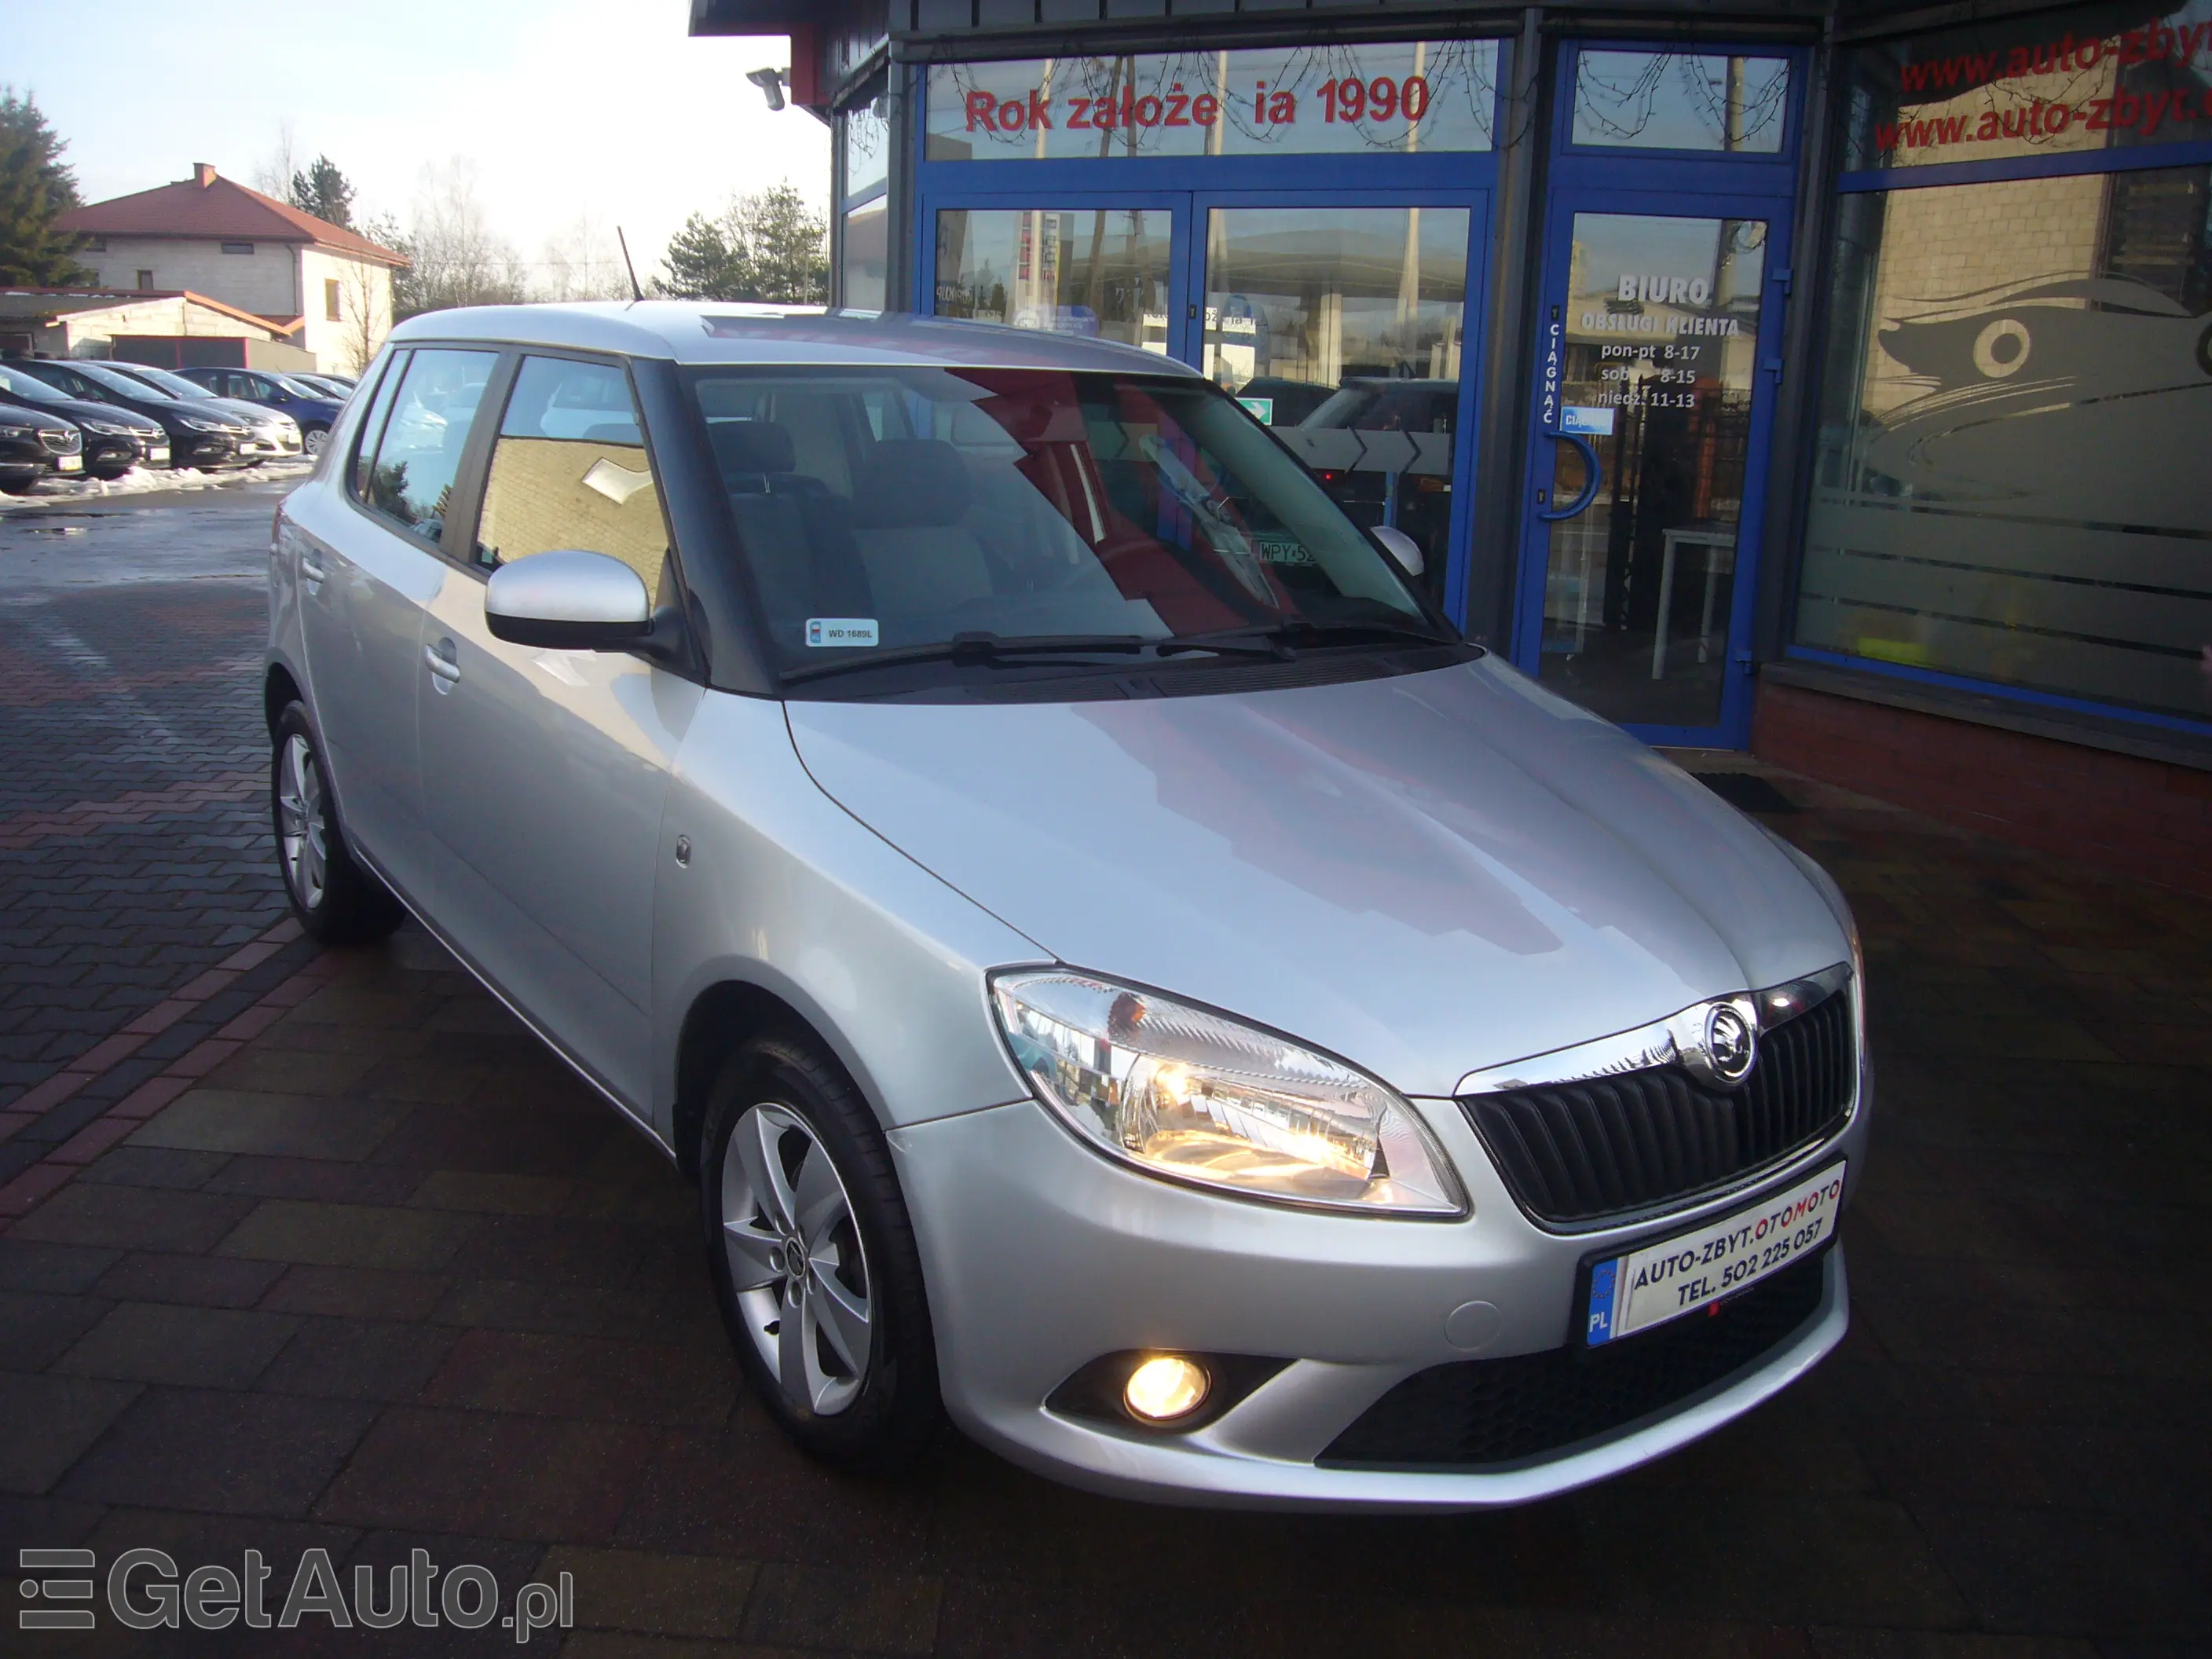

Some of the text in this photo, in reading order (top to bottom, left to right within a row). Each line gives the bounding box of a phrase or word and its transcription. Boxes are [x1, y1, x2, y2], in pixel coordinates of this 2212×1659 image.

[966, 89, 1052, 133] Rok
[1317, 75, 1429, 123] 1990
[1618, 275, 1711, 304] BIURO
[1581, 313, 1738, 337] OBSŁUGI KLIENTA
[1601, 344, 1701, 361] pon-pt 8-17
[1543, 324, 1560, 424] CIĄGNĄĆ
[1660, 371, 1696, 384] 8-15
[1650, 393, 1695, 408] 11-13
[1262, 544, 1291, 561] WPY
[829, 629, 844, 638] WD
[1634, 1179, 1840, 1290] AUTO-ZBYT.OTOMOTO
[1678, 1276, 1716, 1306] TEL.
[1721, 1254, 1758, 1287] 502
[1760, 1236, 1790, 1269] 225
[1793, 1217, 1823, 1250] 057
[1589, 1312, 1608, 1332] PL
